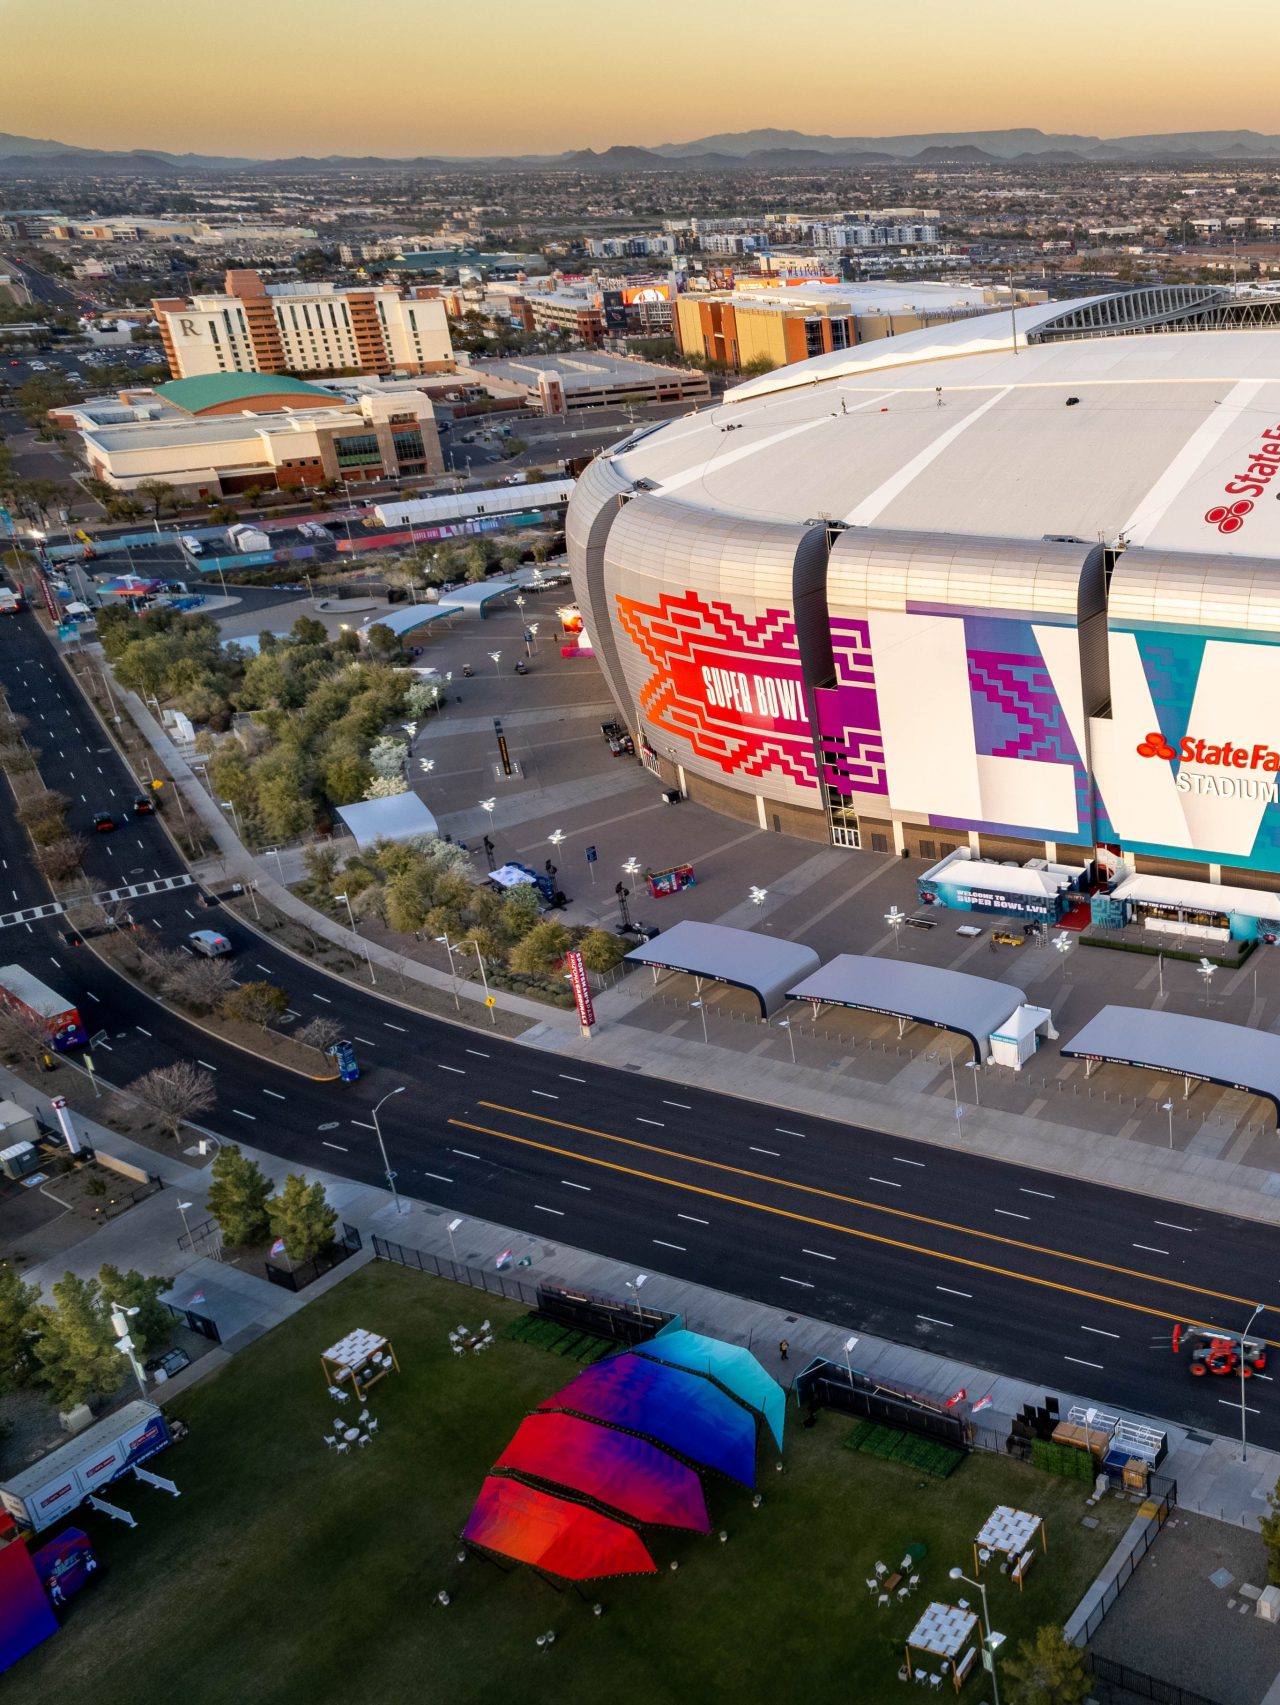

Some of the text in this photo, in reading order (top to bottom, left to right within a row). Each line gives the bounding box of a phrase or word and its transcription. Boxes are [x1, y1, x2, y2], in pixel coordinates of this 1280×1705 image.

[180, 318, 202, 337] R
[702, 666, 809, 722] SUPER BOWL
[1176, 772, 1280, 804] STADIUM
[956, 890, 994, 900] WELCOME
[957, 896, 1047, 914] SUPER BOWL LVII
[1192, 908, 1218, 916] HOSPITALITY
